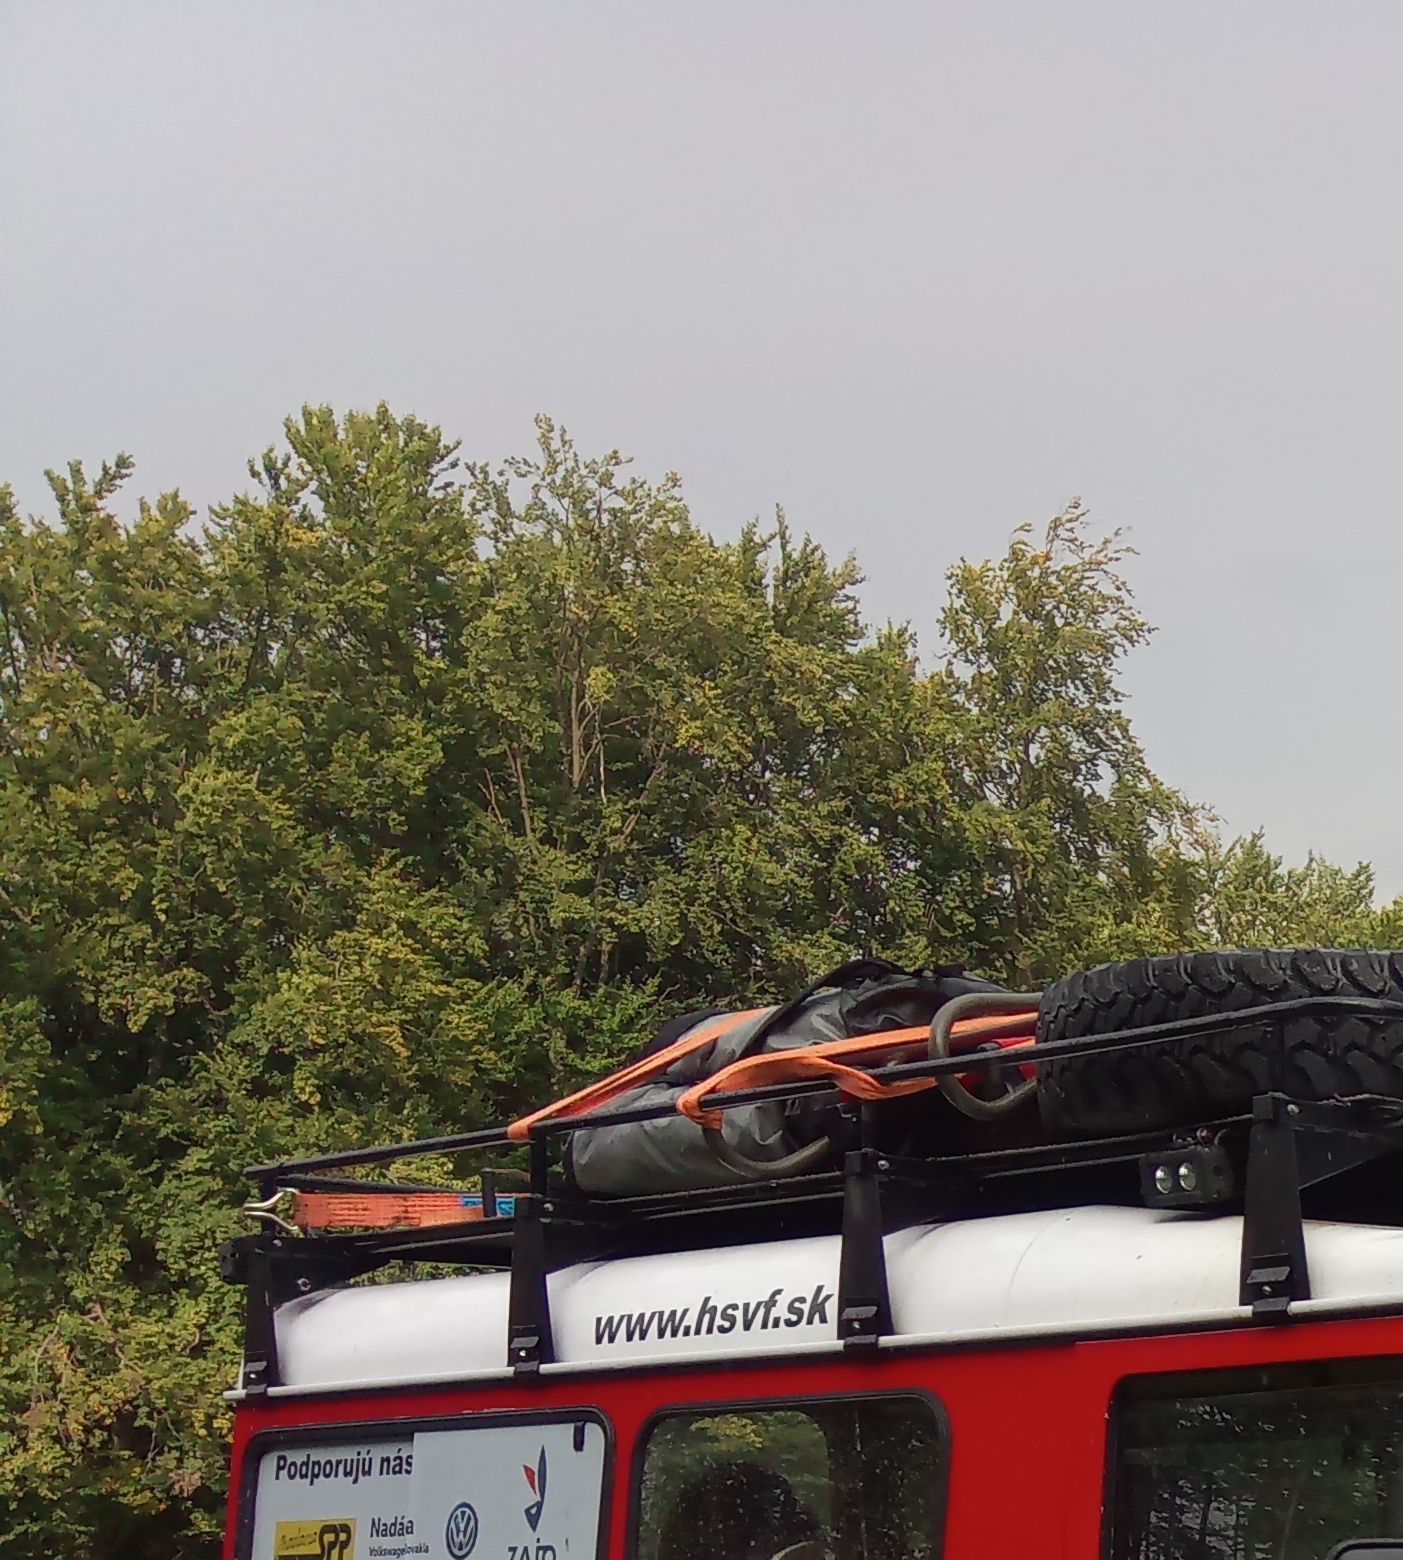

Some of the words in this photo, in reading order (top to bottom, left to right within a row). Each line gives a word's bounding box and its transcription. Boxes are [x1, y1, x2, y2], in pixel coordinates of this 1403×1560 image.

[595, 1285, 834, 1345] www.hsvf.sk
[274, 1449, 372, 1486] Podporujú
[379, 1448, 413, 1476] nás
